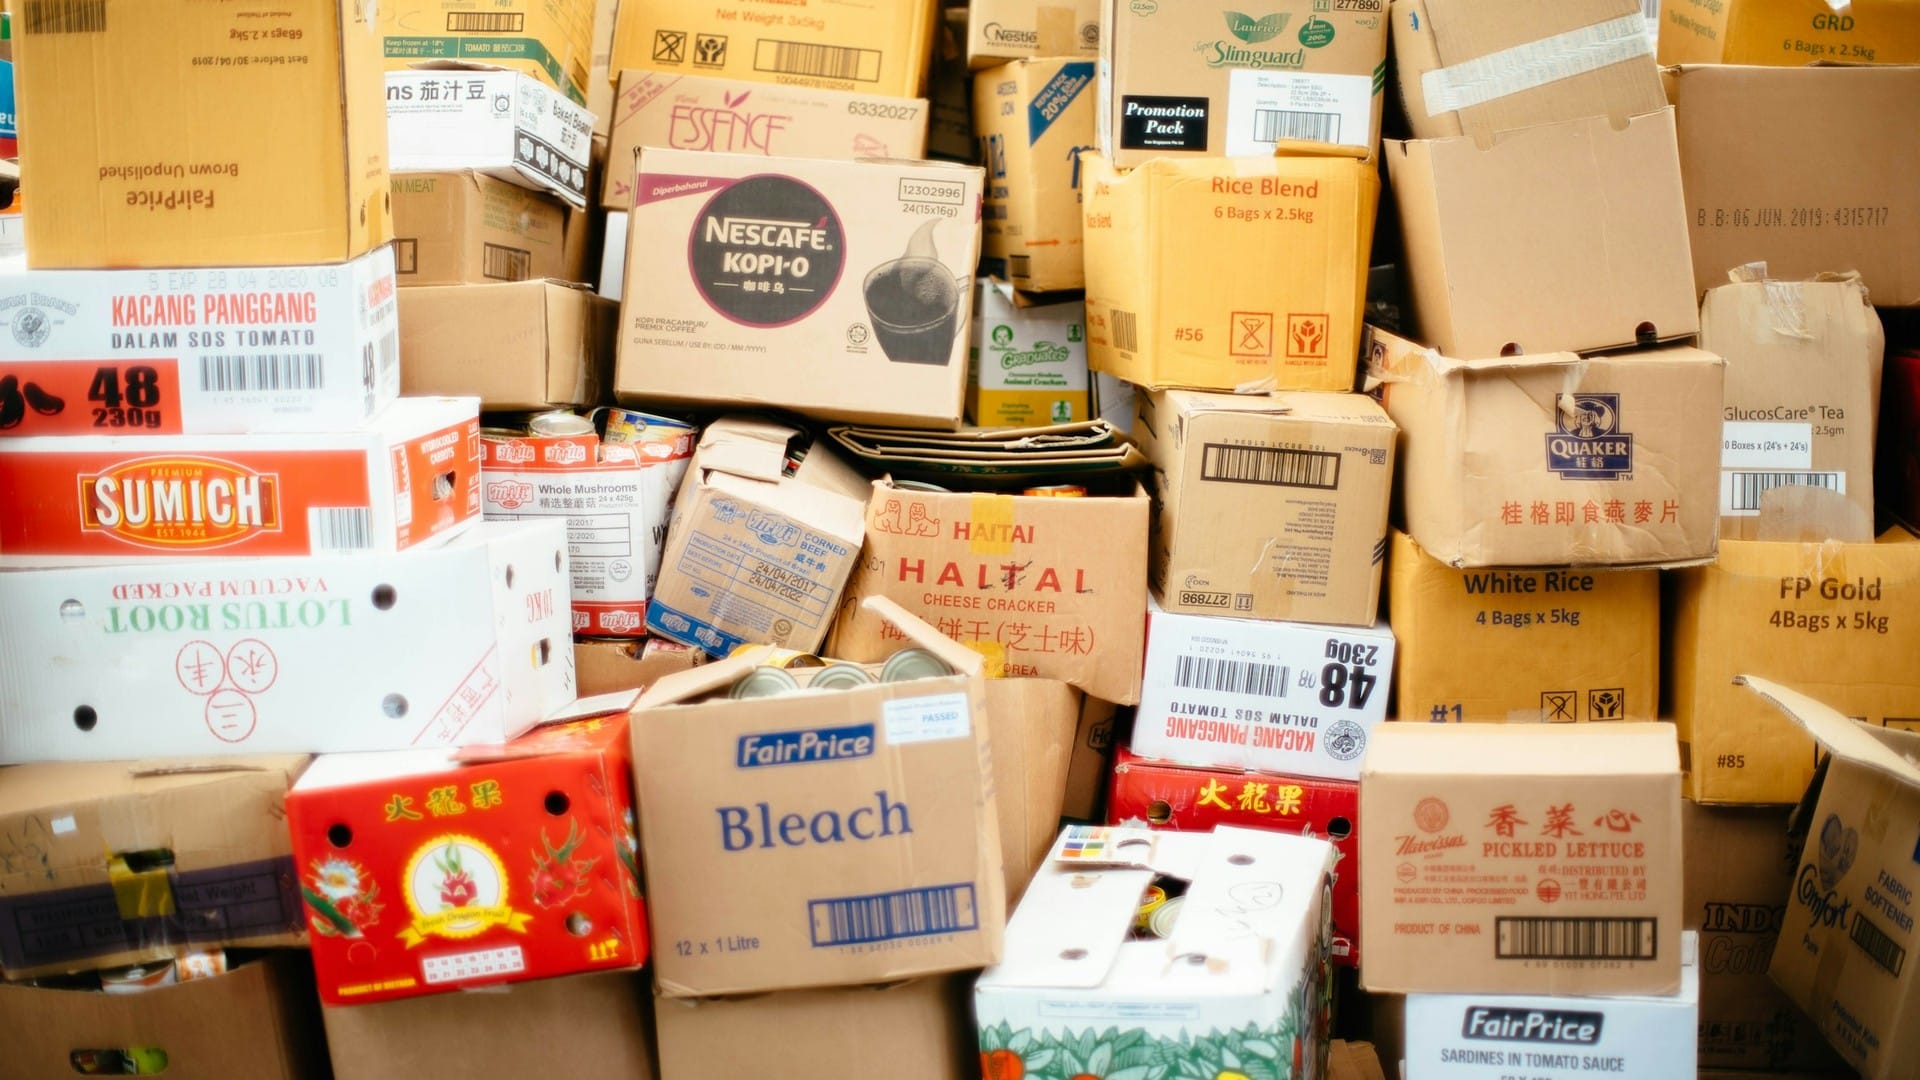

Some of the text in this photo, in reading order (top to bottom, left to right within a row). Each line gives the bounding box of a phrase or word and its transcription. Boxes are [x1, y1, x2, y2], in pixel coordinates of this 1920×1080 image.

[716, 8, 737, 21] Net
[742, 10, 783, 27] Weight
[1233, 19, 1280, 33] Laurier
[1812, 13, 1855, 32] GRD
[229, 28, 259, 41] 2.5kg
[464, 44, 490, 53] TOMATO
[1207, 40, 1303, 68] Slimguard
[1783, 40, 1791, 50] 6
[1795, 39, 1824, 55] Bags
[1839, 44, 1876, 60] 2.5kg
[420, 80, 486, 101] 茄汁豆
[848, 101, 918, 121] 6332027
[1124, 101, 1206, 119] Promotion
[1145, 119, 1185, 135] Pack
[99, 162, 239, 181] Brown Unpolished
[405, 179, 437, 193] MEAT
[902, 184, 961, 199] 12302996
[1212, 175, 1319, 199] Rice Blend
[126, 189, 215, 211] FairPrice
[1214, 207, 1314, 224] 6 Bags x 2.5kg
[169, 272, 197, 290] EXP
[208, 271, 227, 289] 28
[238, 271, 257, 289] 04
[268, 270, 307, 289] 2020
[111, 291, 317, 327] KACANG PANGGANG
[111, 329, 315, 350] DALAM SOS TOMATO
[1174, 328, 1203, 343] #56
[88, 366, 161, 408] 48
[92, 408, 162, 429] 230g
[1818, 405, 1845, 420] Tea
[1815, 425, 1846, 438] 2.5gm
[1550, 438, 1629, 457] QUAKER
[1732, 440, 1756, 451] Boxes
[538, 483, 638, 495] Whole Mushrooms
[95, 474, 264, 528] SUMICH
[1501, 499, 1681, 526] 桂格即食燕麥片
[952, 520, 1035, 545] HAITAI
[800, 542, 828, 558] BEEF
[803, 532, 848, 557] CORNED
[748, 573, 805, 603] 24/04/2022
[755, 561, 818, 594] 24/04/2017
[1463, 571, 1595, 596] White Rice
[112, 577, 329, 601] VACUUM PACKED
[1780, 576, 1883, 601] FP Gold
[923, 592, 1056, 613] CHEESE CRACKER
[1183, 593, 1228, 606] 277898
[103, 597, 353, 635] LOTUS ROOT
[1476, 608, 1581, 629] 4 Bags x 5kg
[1768, 609, 1889, 634] 4Bags x 5kg
[1325, 638, 1380, 667] 230g
[1318, 662, 1378, 710] 48
[921, 711, 960, 723] PASSED
[1170, 701, 1318, 729] DALAM SOS TOMATO
[1430, 703, 1464, 723] #1
[1166, 716, 1316, 754] KACANG PANGGANG
[742, 732, 871, 766] FairPrice
[1717, 753, 1745, 770] #85
[385, 779, 503, 823] 火龍果
[1197, 777, 1303, 817] 火龍果
[715, 790, 914, 853] Bleach
[1484, 803, 1643, 839] 香菜心
[1482, 841, 1646, 859] PICKLED LETTUCE
[1562, 865, 1647, 877] DISTRIBUTED BY
[205, 881, 256, 902] Weight
[1797, 863, 1854, 931] Comfort
[1877, 868, 1914, 906] FABRIC
[1864, 886, 1915, 934] SOFTENER
[1394, 923, 1481, 935] PRODUCT OF CHINA
[675, 940, 692, 957] 12
[700, 943, 709, 955] x
[728, 935, 761, 952] Litre
[1468, 1009, 1596, 1042] FairPrice
[1441, 1047, 1625, 1073] SARDINES IN TOMATO SAUCE
